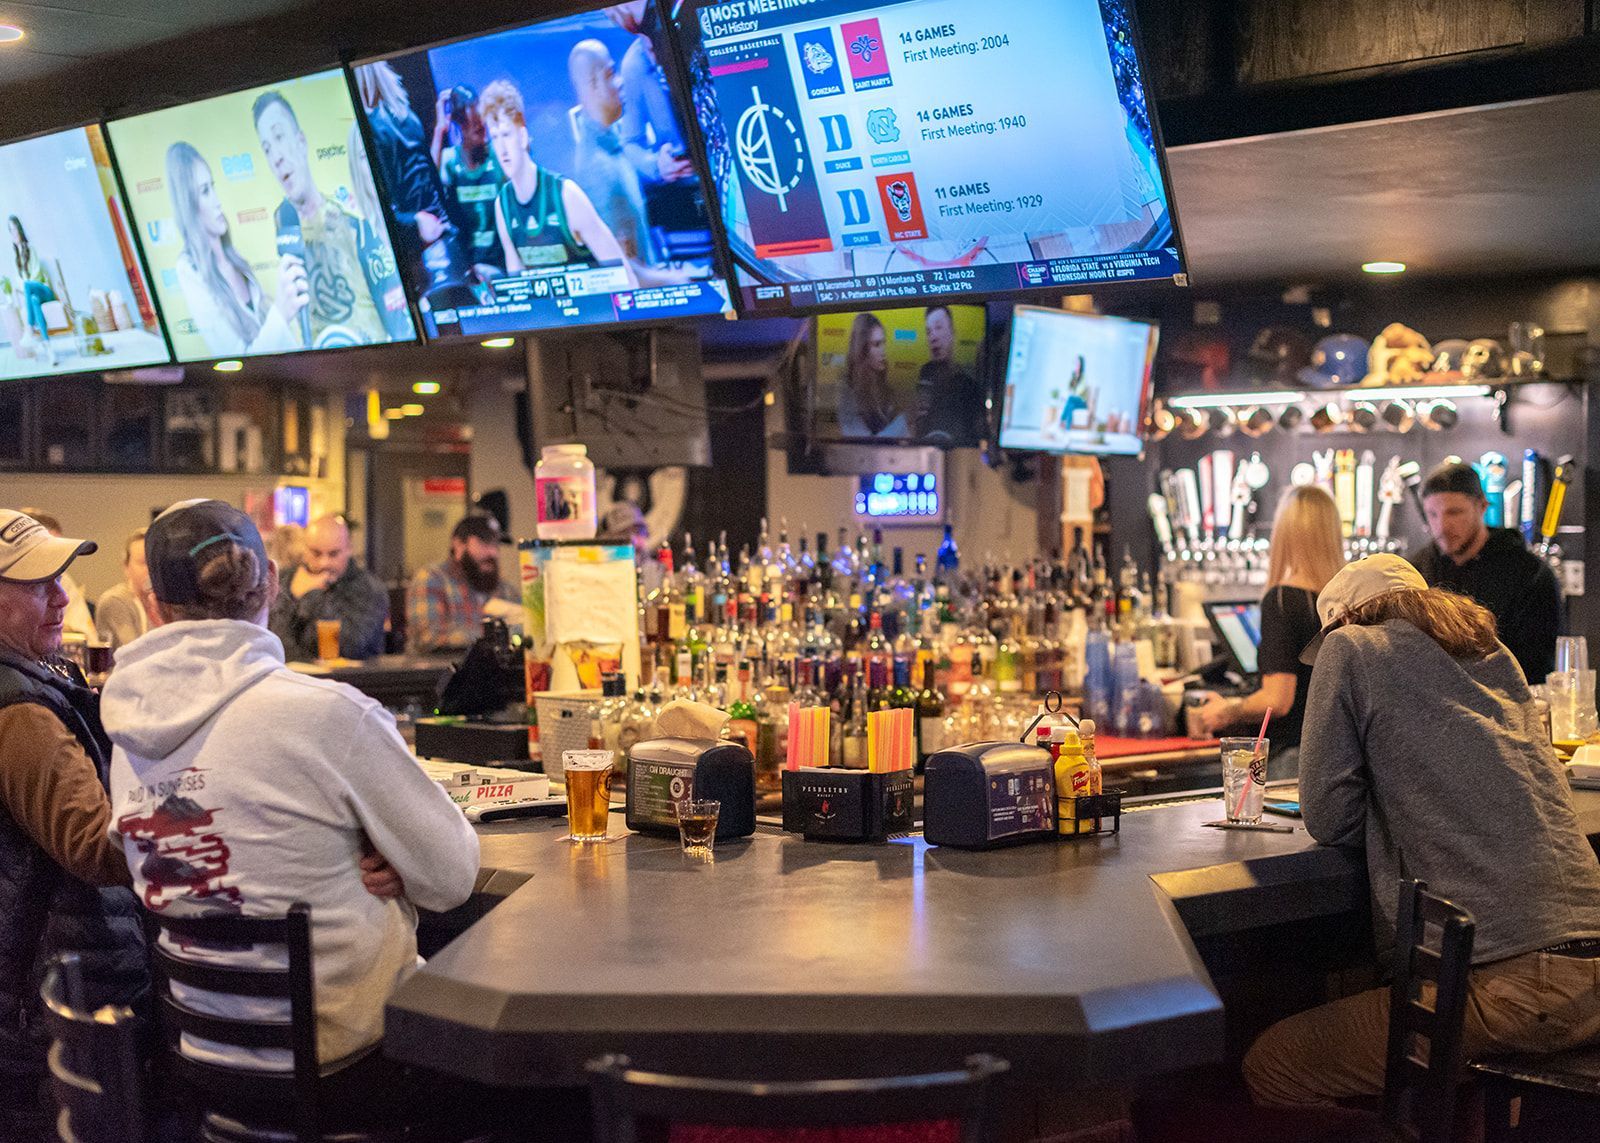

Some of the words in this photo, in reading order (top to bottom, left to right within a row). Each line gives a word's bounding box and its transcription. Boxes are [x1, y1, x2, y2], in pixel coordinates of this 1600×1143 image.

[710, 2, 746, 23] MOST
[730, 19, 759, 34] History
[899, 31, 912, 44] 14
[915, 24, 956, 41] GAMES
[709, 43, 738, 57] COLLEGE
[739, 38, 780, 53] BASKETBALL
[903, 48, 928, 63] First
[930, 41, 980, 59] Meeting:
[980, 34, 1009, 50] 2004
[811, 86, 841, 97] GONZAGA
[917, 111, 930, 122] 14
[932, 104, 974, 120] GAMES
[921, 127, 946, 140] First
[947, 121, 997, 136] Meeting:
[998, 115, 1027, 130] 1940
[835, 161, 852, 170] DUKE
[934, 187, 947, 199] 11
[949, 182, 991, 198] GAMES
[939, 205, 964, 217] First
[965, 199, 1015, 213] Meeting:
[1016, 194, 1043, 208] 1929
[1055, 263, 1081, 274] FLORIDA
[1081, 262, 1099, 272] STATE
[1114, 258, 1142, 269] VIRGINIA
[1143, 256, 1160, 267] TECH
[886, 275, 915, 285] Montana
[915, 273, 925, 283] St
[933, 272, 943, 282] 72
[948, 270, 960, 280] 2nd
[960, 269, 976, 280] 0:22
[1051, 271, 1088, 283] WEDNESDAY
[1088, 270, 1107, 280] NOON
[1107, 269, 1115, 279] ET
[570, 278, 584, 292] 72
[854, 279, 862, 289] St
[866, 277, 876, 287] 69
[952, 282, 961, 292] 12
[961, 281, 972, 291] Pts
[756, 286, 784, 299] ESPN
[820, 292, 834, 302] SAC
[649, 765, 659, 775] ON
[659, 766, 689, 778] DRAUGHT
[476, 784, 514, 799] PIZZA
